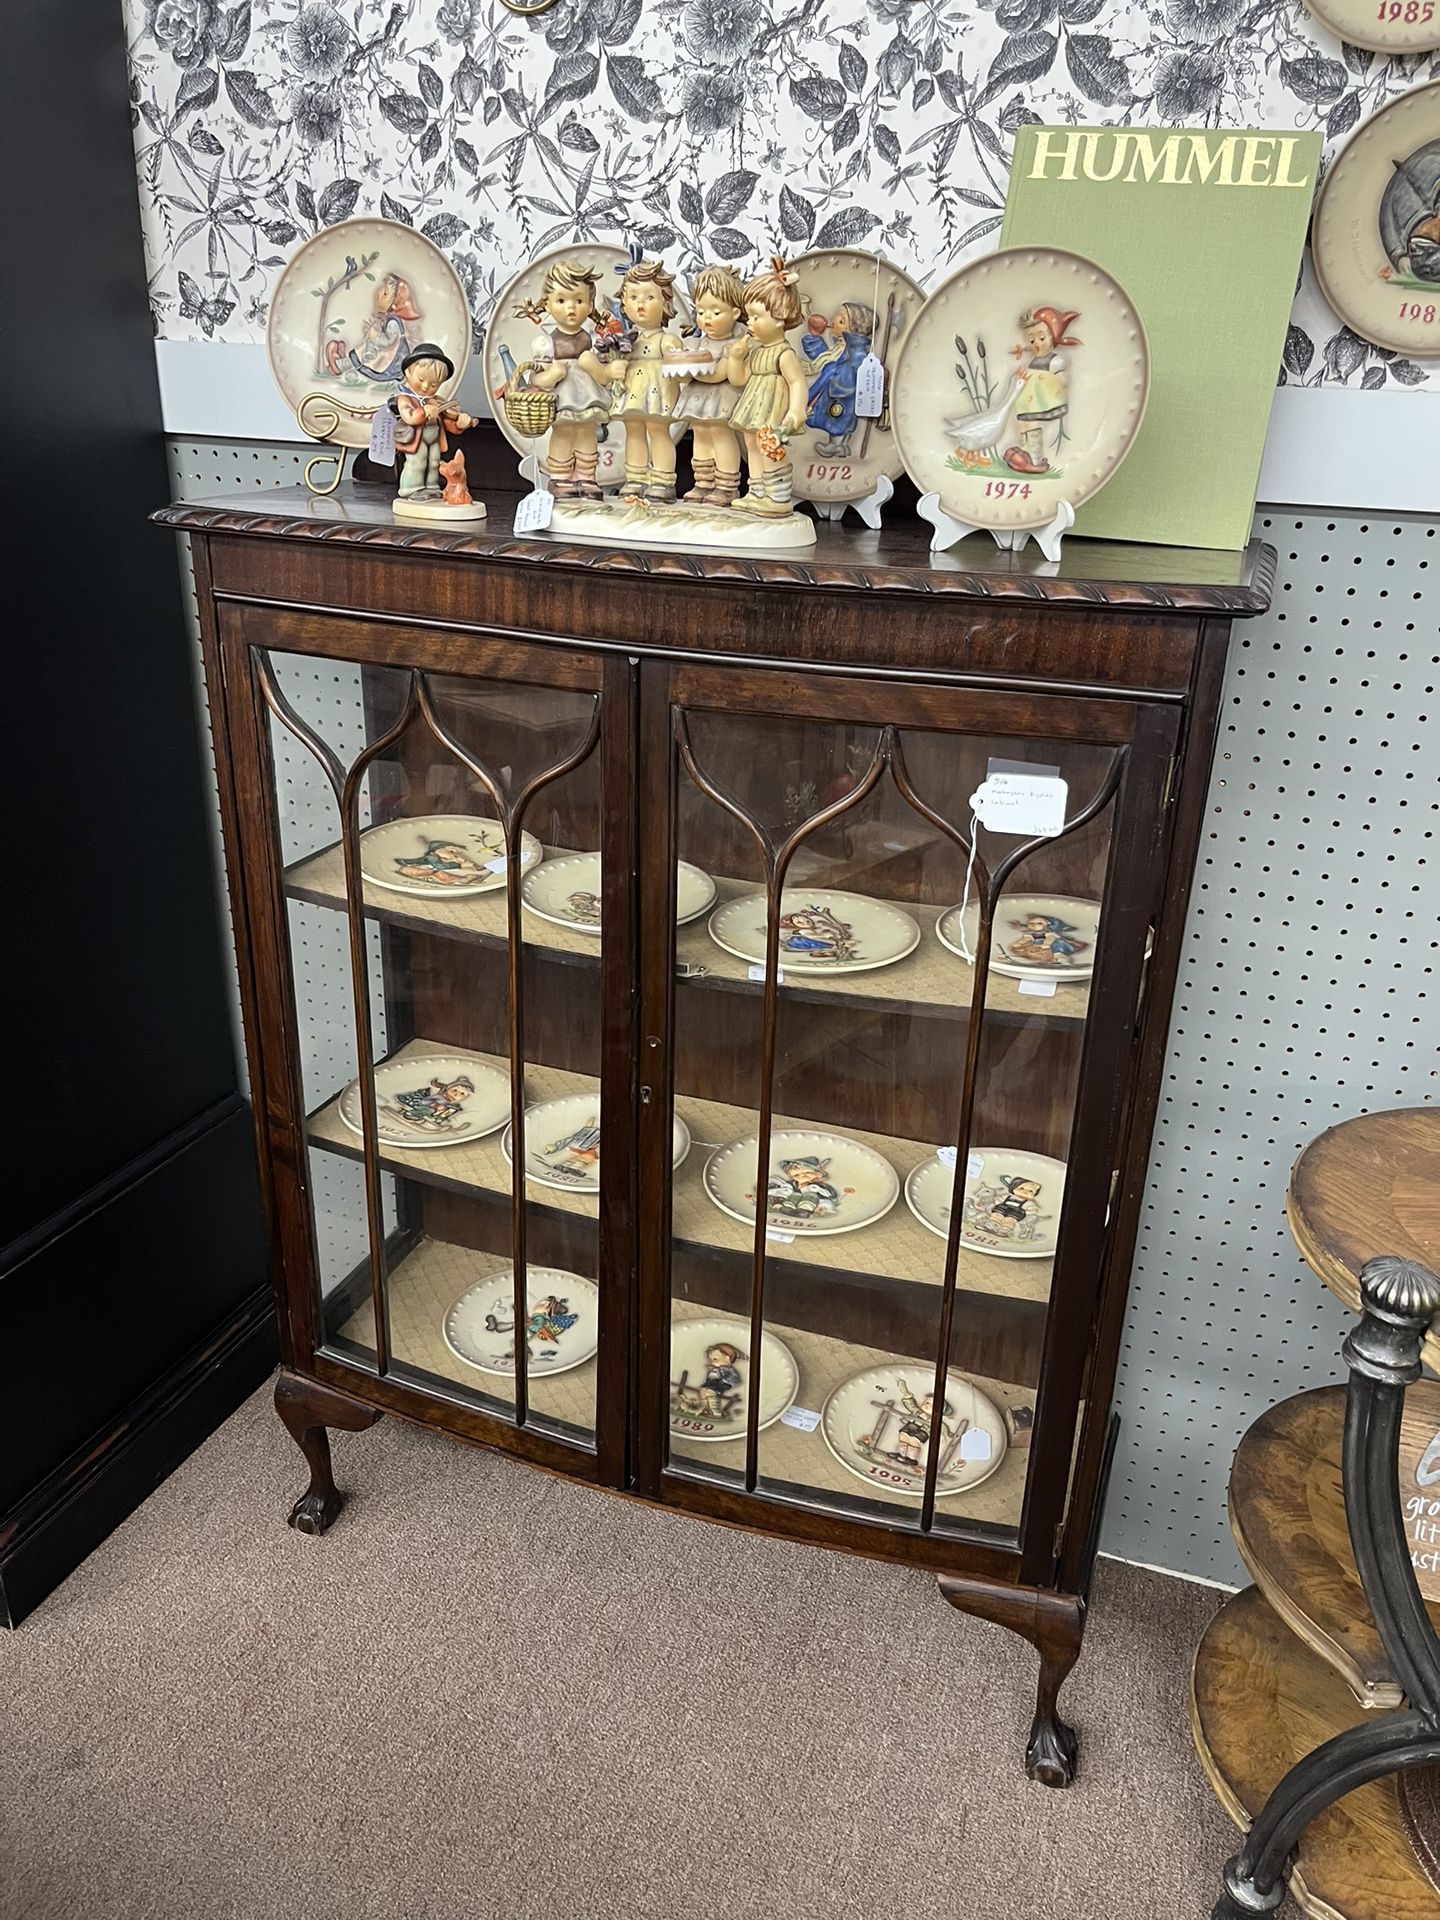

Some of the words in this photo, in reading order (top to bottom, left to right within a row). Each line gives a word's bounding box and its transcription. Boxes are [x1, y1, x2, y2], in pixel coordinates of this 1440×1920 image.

[1377, 0, 1435, 24] 1985
[1026, 131, 1309, 187] HUMMEL
[1399, 302, 1440, 323] 198
[806, 464, 852, 481] 1972
[984, 481, 1032, 499] 1974
[965, 1231, 999, 1246] 988
[672, 1418, 714, 1432] 1989
